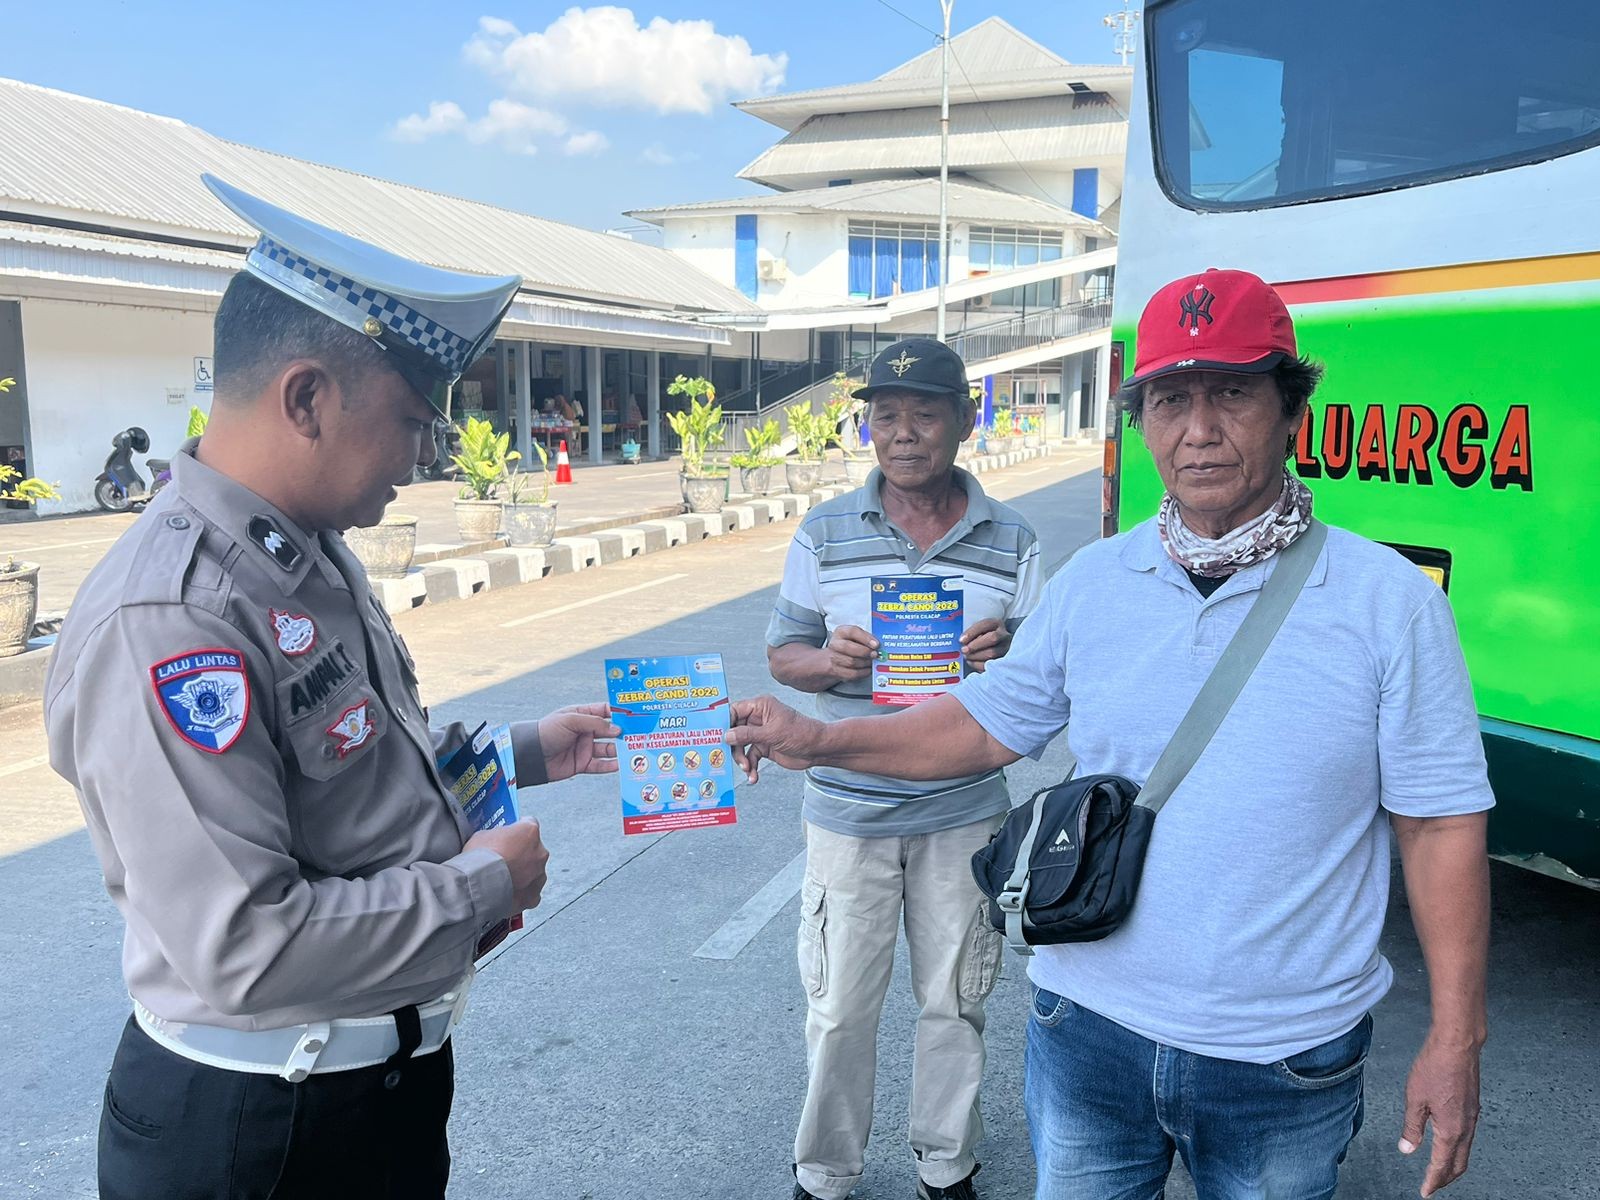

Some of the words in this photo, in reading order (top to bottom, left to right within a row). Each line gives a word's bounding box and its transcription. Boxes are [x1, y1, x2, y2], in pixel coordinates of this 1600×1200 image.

[1296, 404, 1534, 492] LUARGA
[900, 592, 937, 602] OPERASI
[877, 602, 905, 612] ZEBRA
[906, 602, 934, 612] CANDI
[935, 601, 958, 611] 2024
[159, 659, 190, 677] LALU
[195, 656, 236, 666] LINTAS
[645, 676, 689, 688] OPERASI
[617, 692, 653, 704] ZEBRA
[655, 689, 688, 700] CANDI
[691, 687, 719, 698] 2024
[643, 703, 672, 711] POLRESTA
[659, 716, 686, 728] MARI
[624, 734, 647, 742] PATUHI
[649, 731, 685, 740] PERATURAN
[646, 740, 691, 748] KESELAMATAN
[693, 737, 721, 745] BERSAMA
[477, 759, 497, 788] 2024
